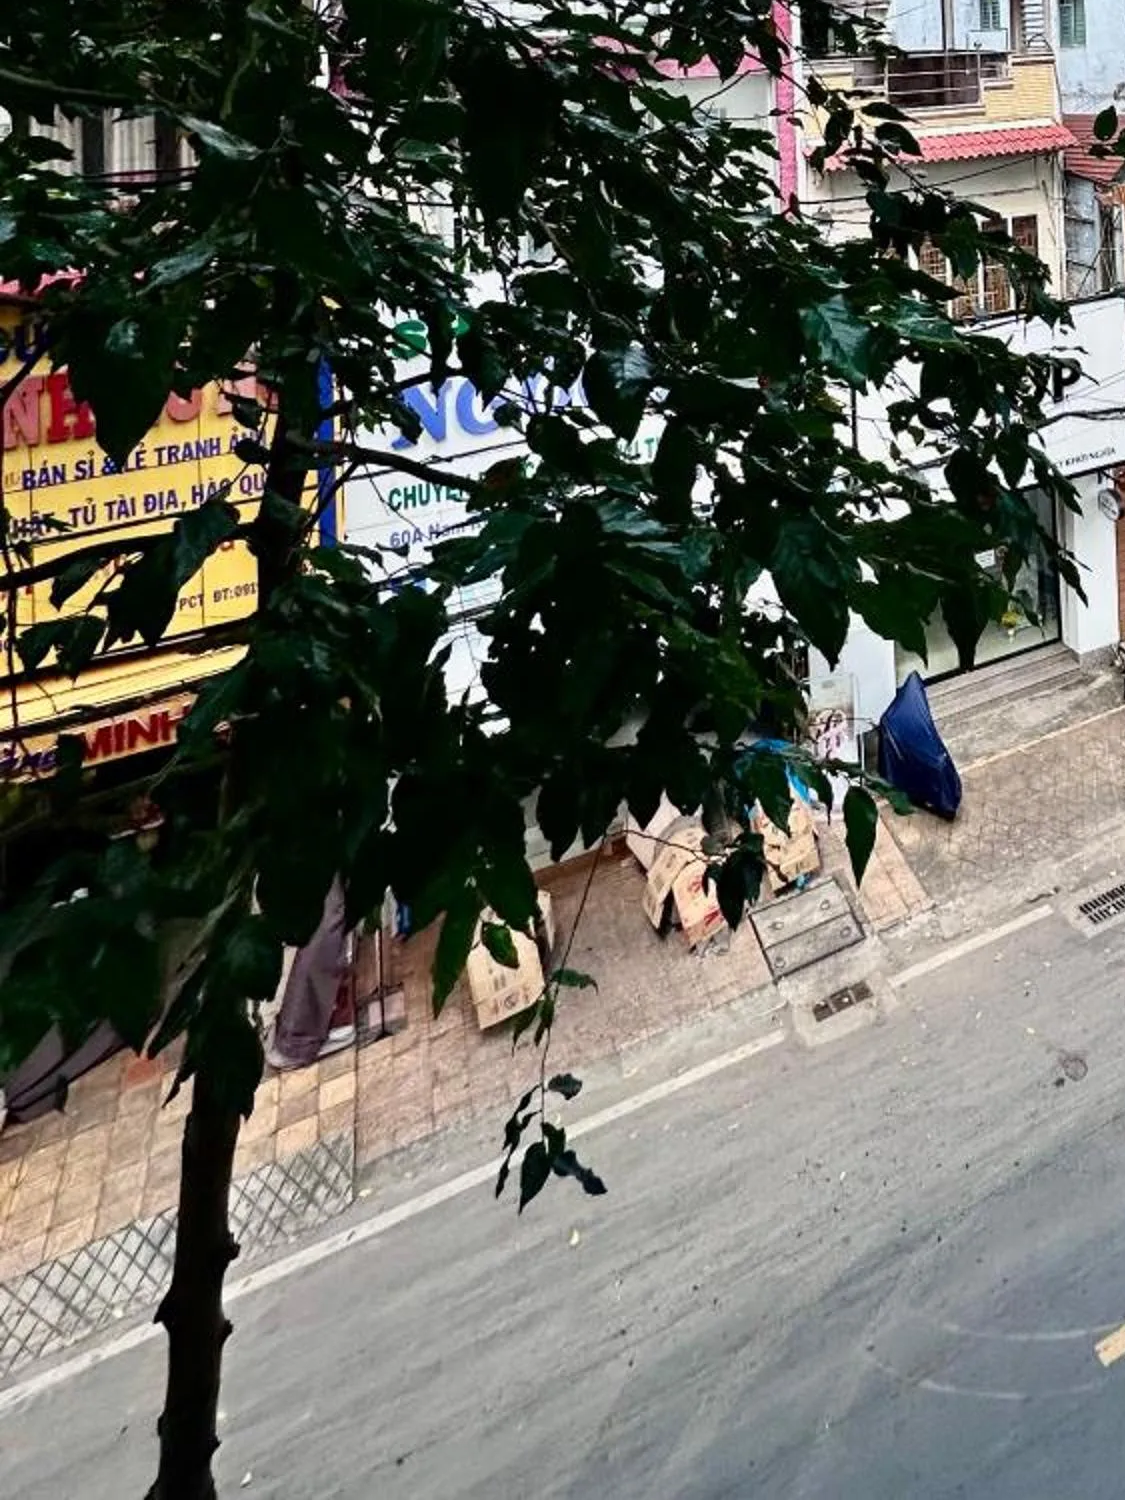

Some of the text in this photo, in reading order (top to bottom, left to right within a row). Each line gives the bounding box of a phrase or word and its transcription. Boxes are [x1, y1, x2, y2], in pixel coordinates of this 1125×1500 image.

[22, 459, 67, 490] BÁN
[74, 449, 95, 480] SỈ
[154, 437, 221, 467] TRANH
[68, 497, 97, 528] TỦ
[103, 493, 136, 521] TÀI
